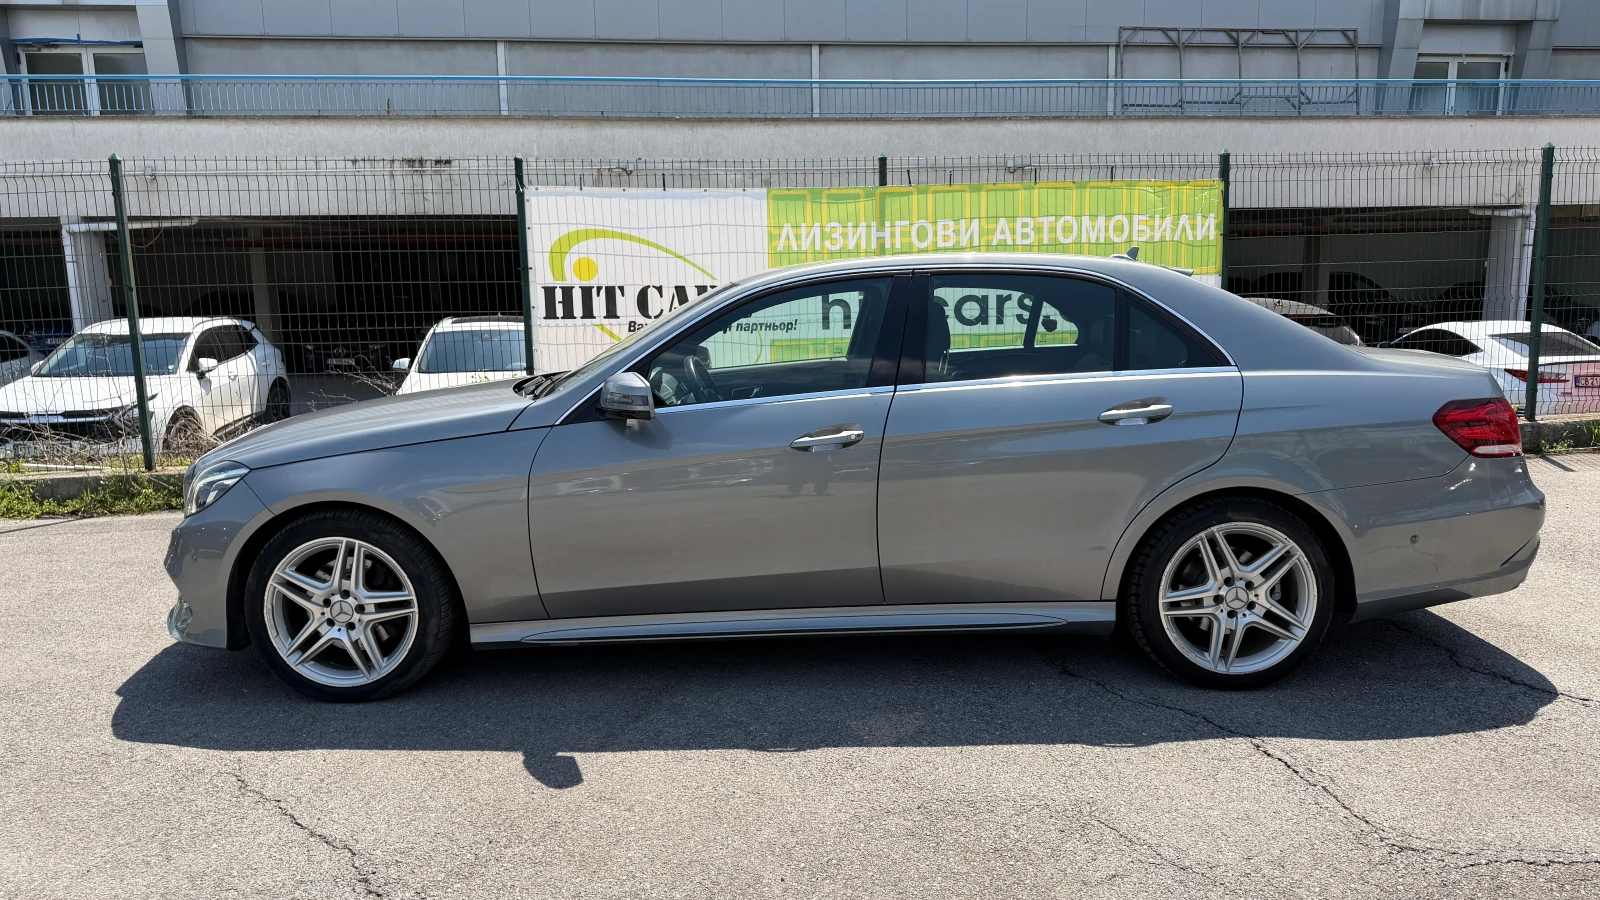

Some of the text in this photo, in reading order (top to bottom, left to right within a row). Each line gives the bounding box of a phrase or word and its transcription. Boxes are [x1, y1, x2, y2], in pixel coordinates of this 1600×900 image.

[778, 213, 1217, 251] ЛИЗИНГОВИ АВТОМОБИЛИ
[541, 286, 626, 320] HIT
[628, 320, 648, 333] Ва
[735, 319, 798, 333] партньор!
